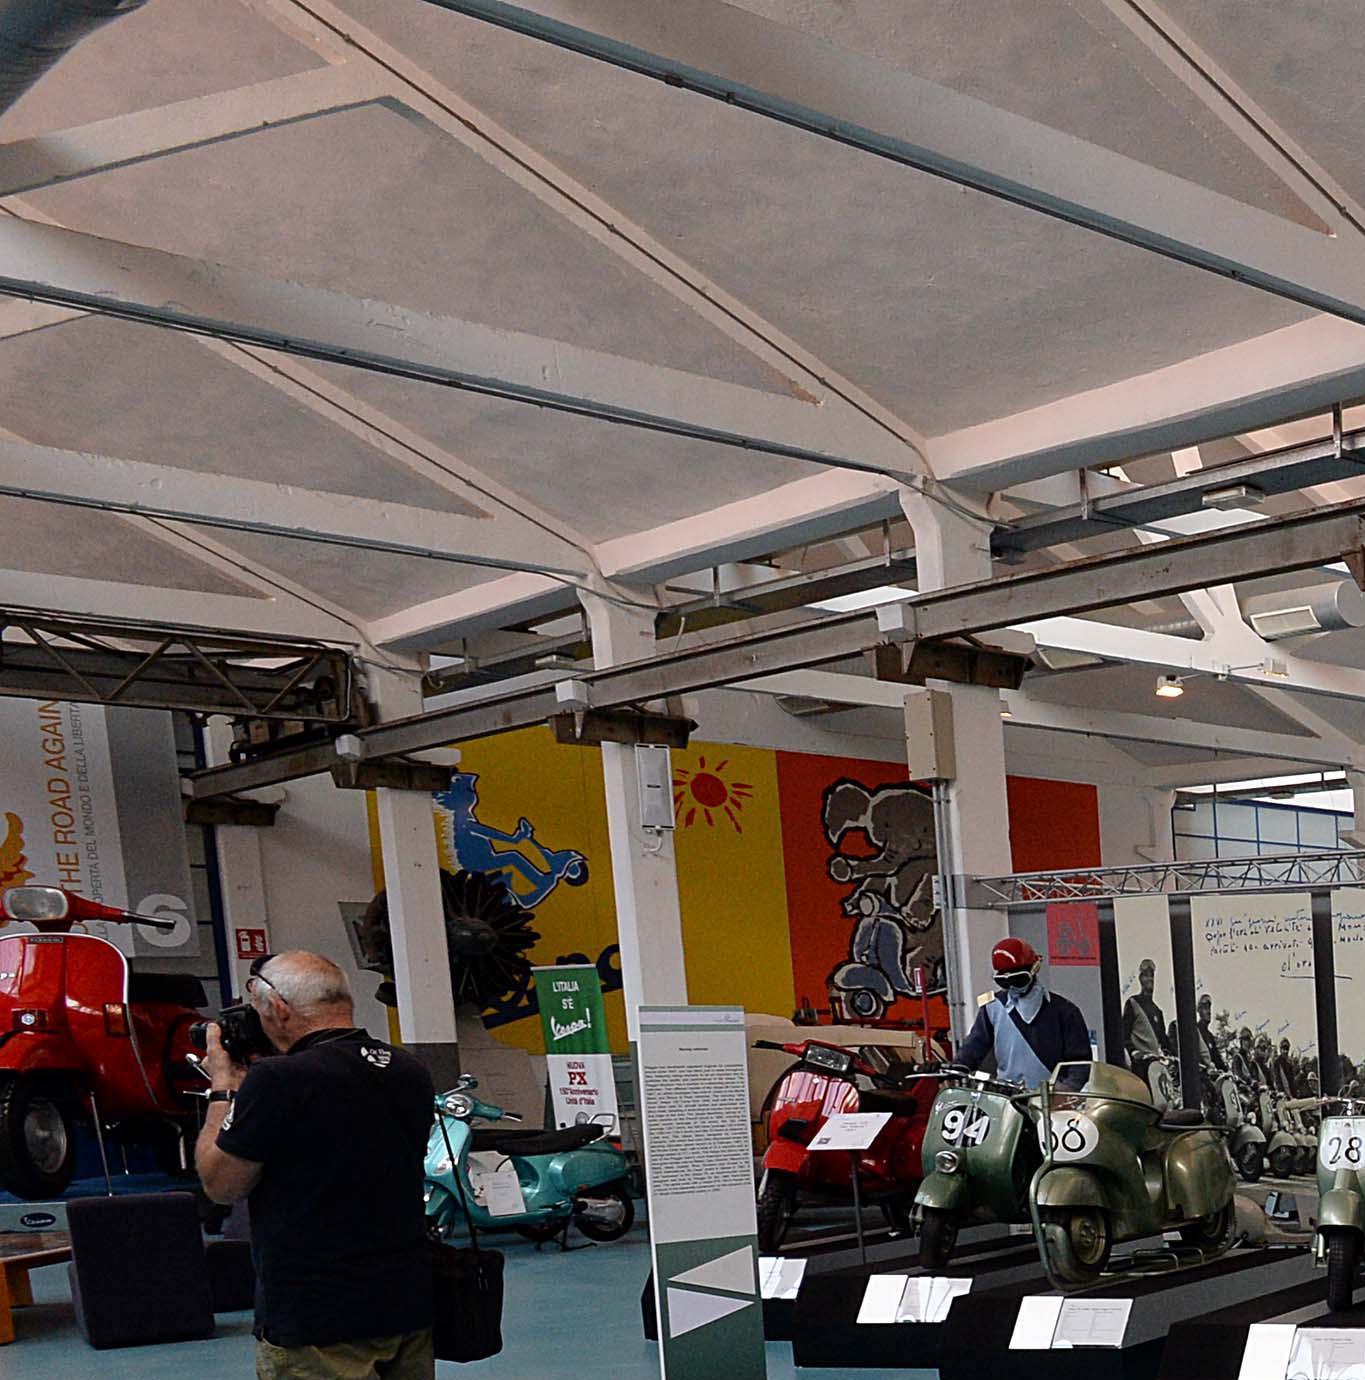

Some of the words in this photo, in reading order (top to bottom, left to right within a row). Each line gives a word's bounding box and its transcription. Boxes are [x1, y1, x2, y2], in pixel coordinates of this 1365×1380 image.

[73, 747, 89, 783] DELLA
[48, 778, 77, 846] ROAD
[78, 795, 96, 836] MONDO
[85, 839, 98, 861] DEL
[56, 852, 83, 893] THE
[567, 1071, 587, 1086] PX
[942, 1110, 990, 1145] 94
[1328, 1136, 1363, 1164] 28
